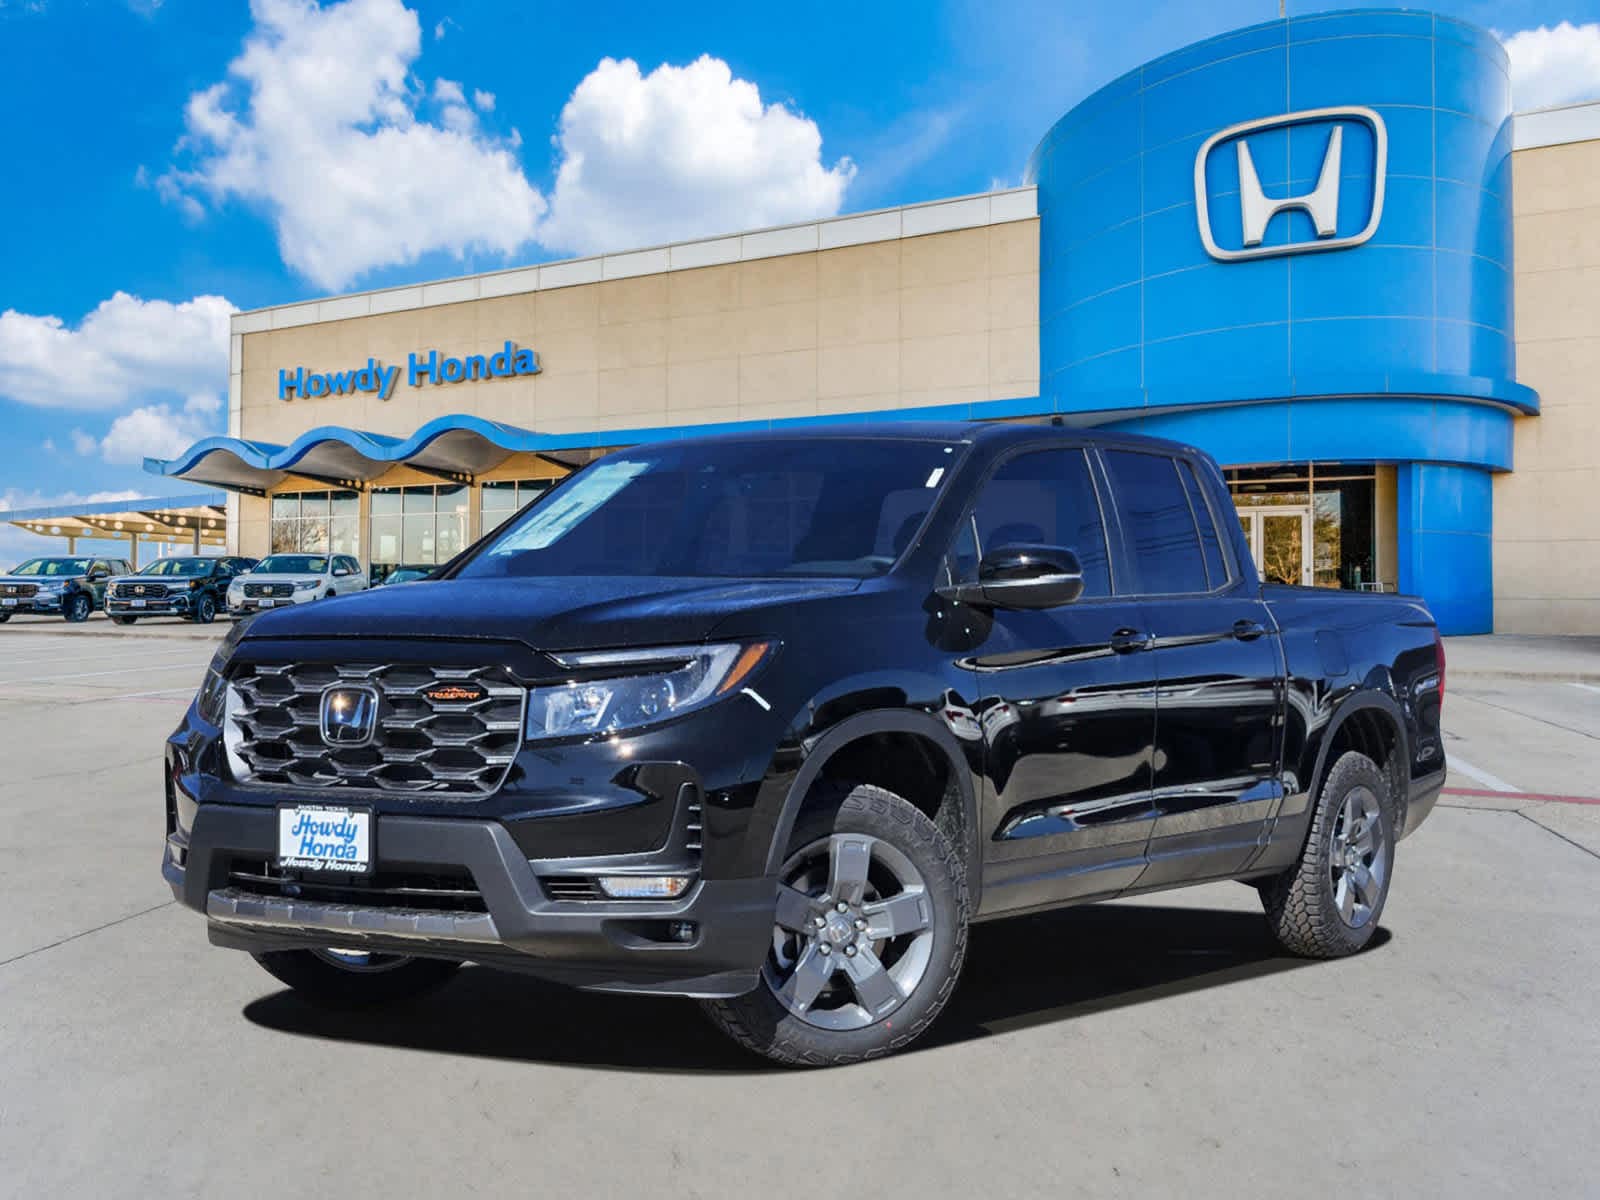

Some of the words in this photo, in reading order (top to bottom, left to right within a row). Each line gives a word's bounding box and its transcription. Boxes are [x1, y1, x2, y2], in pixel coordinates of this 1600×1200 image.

[278, 358, 399, 400] Howdy
[408, 340, 540, 386] Honda
[291, 814, 358, 843] Howdy
[299, 836, 357, 859] Honda
[280, 857, 324, 870] Howdy
[325, 861, 367, 872] Honda
